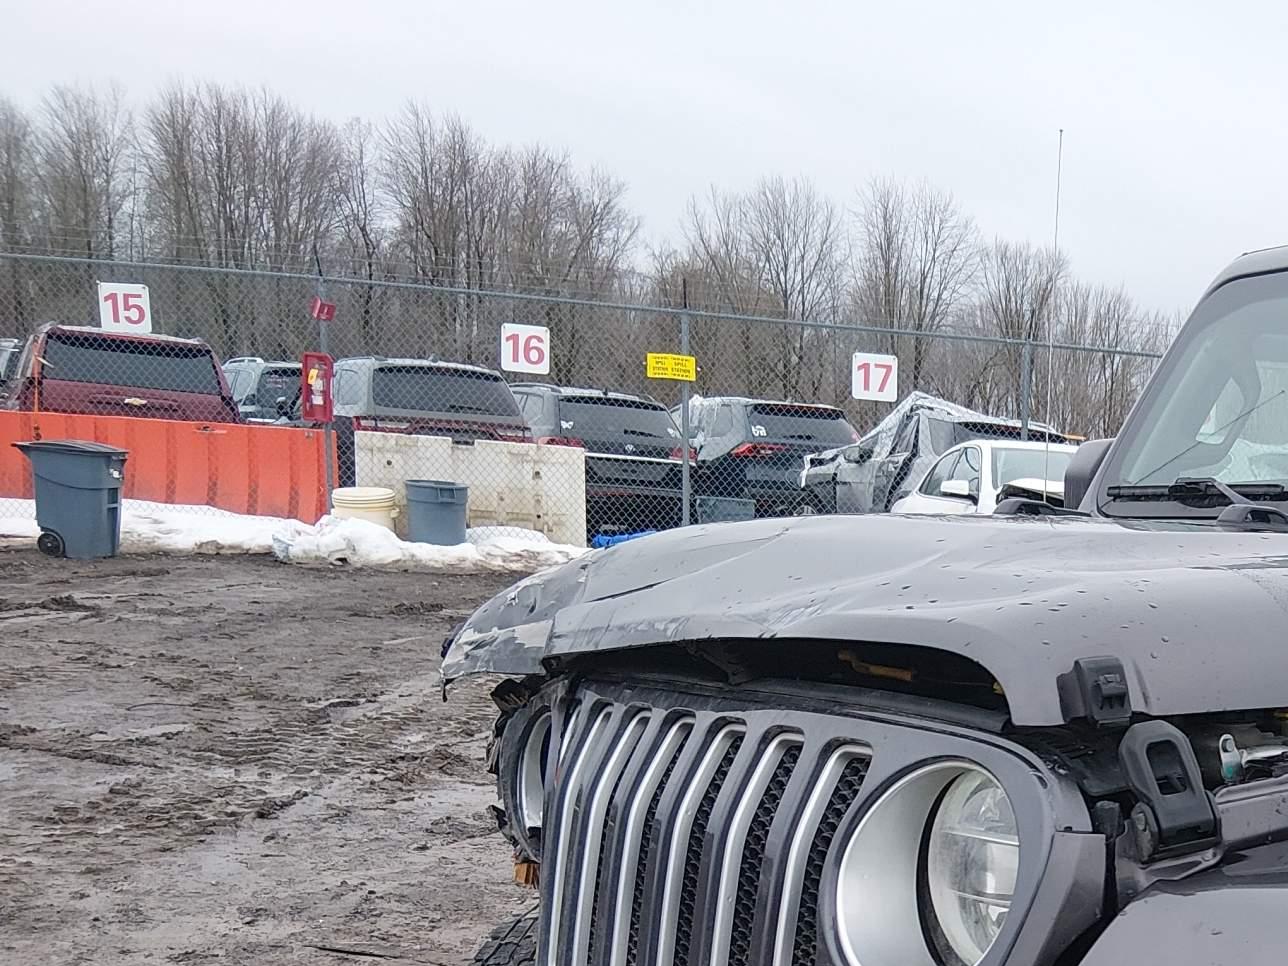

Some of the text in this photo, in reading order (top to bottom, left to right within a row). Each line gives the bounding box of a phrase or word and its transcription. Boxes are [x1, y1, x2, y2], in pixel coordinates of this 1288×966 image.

[103, 292, 146, 325] 15
[505, 333, 545, 366] 16
[857, 362, 893, 392] 17
